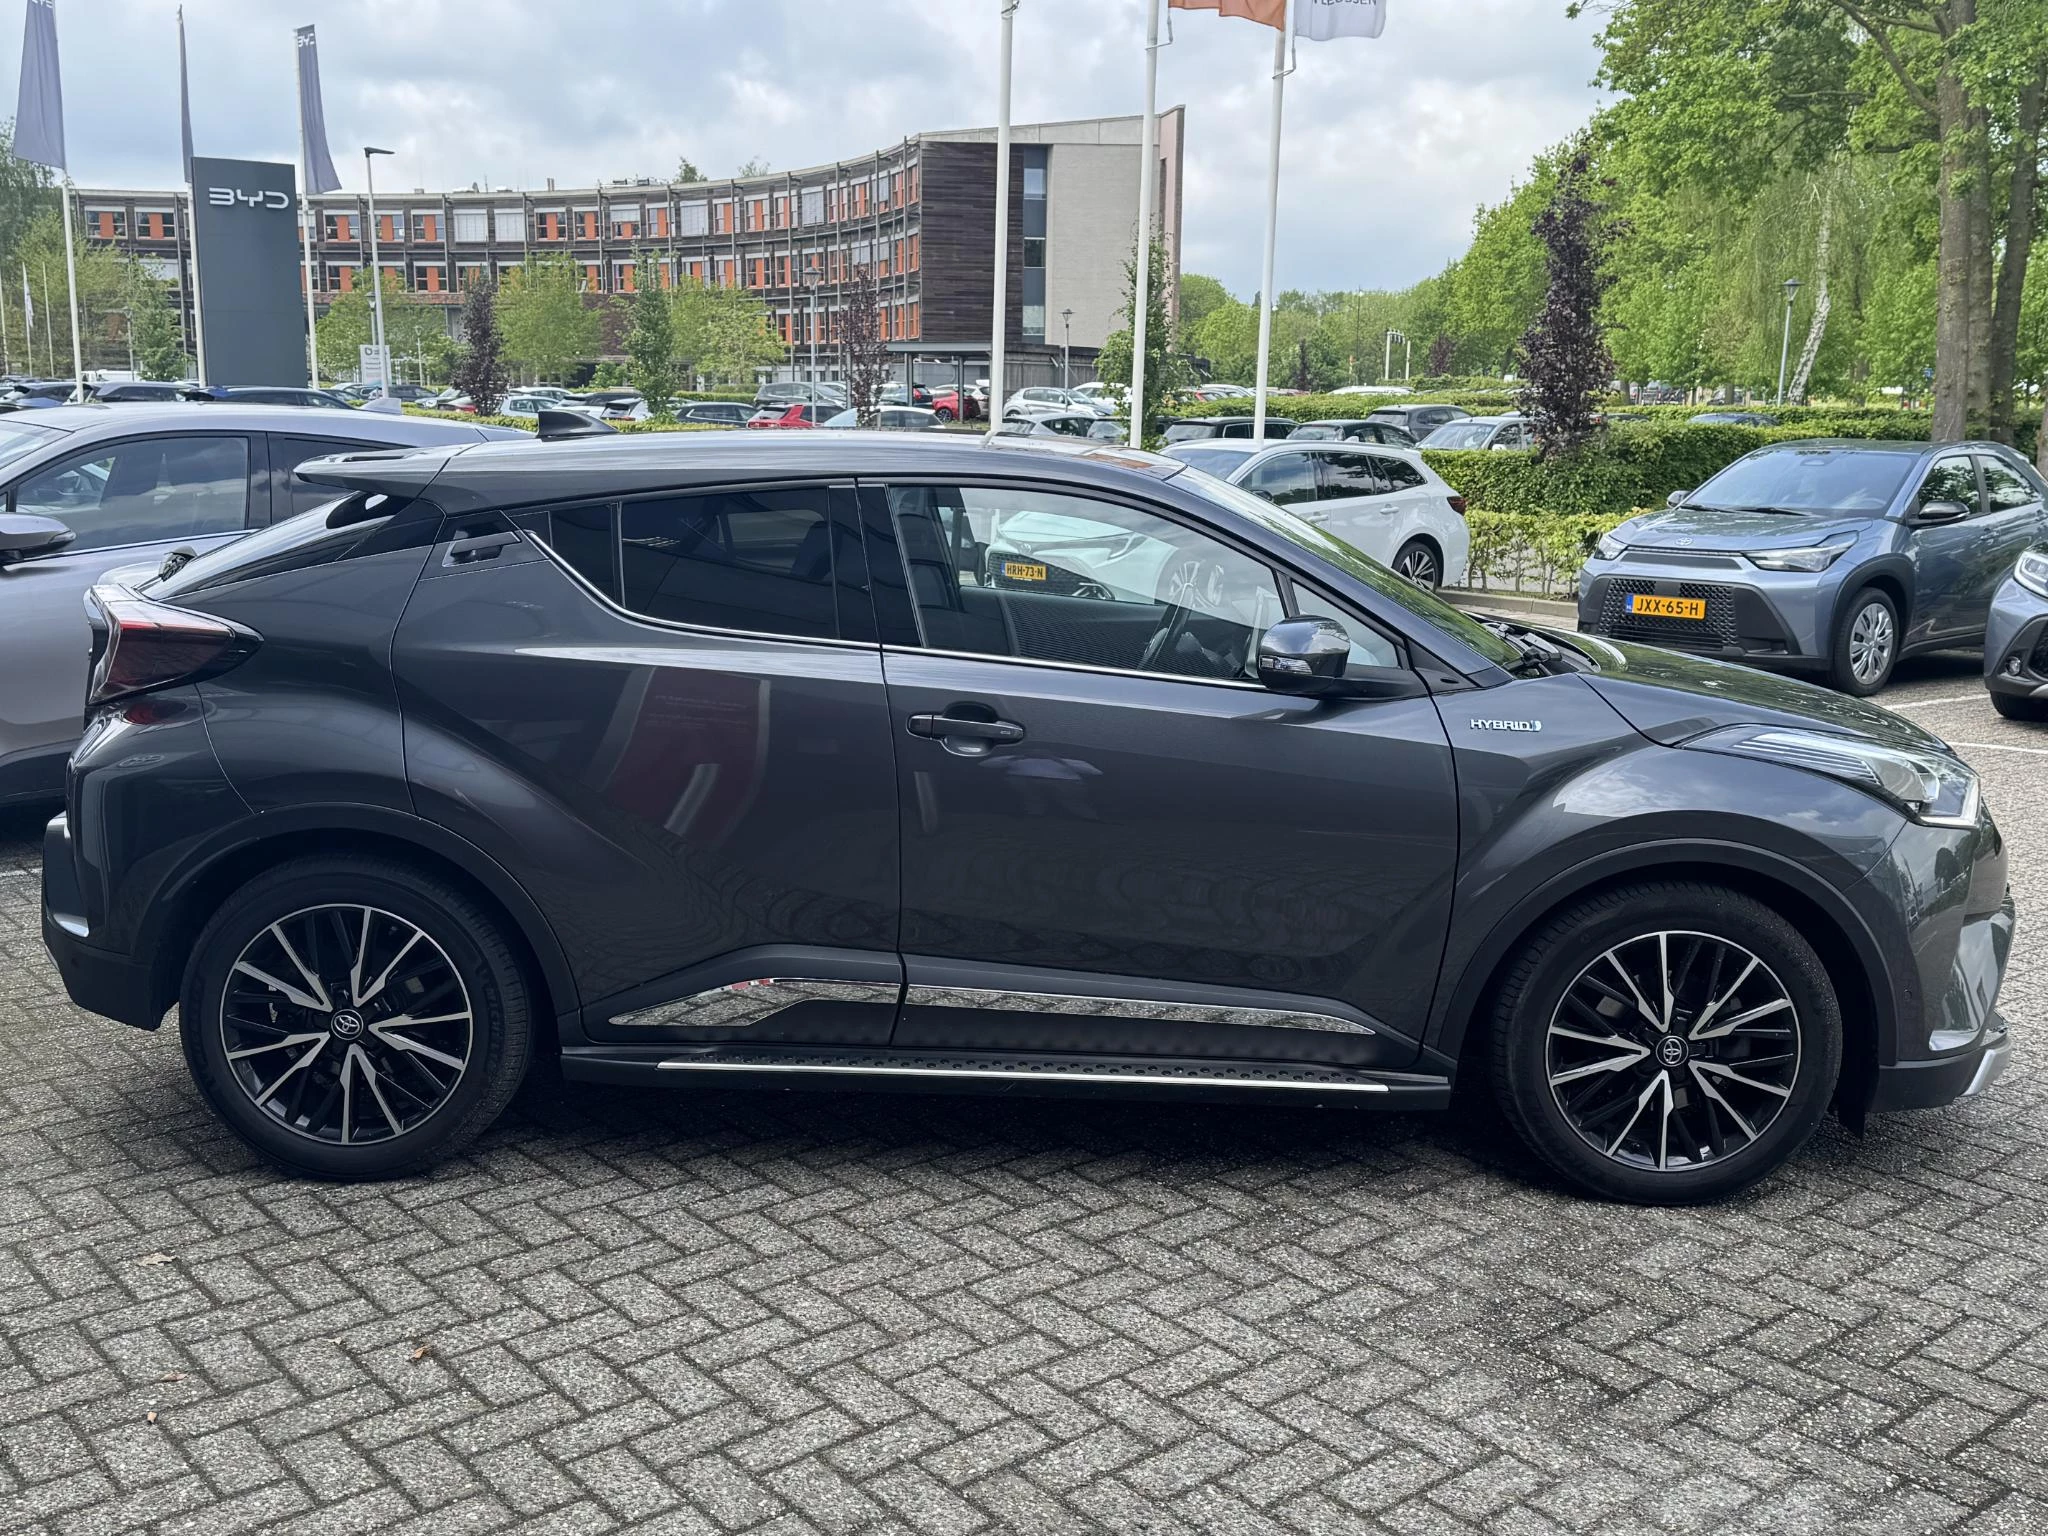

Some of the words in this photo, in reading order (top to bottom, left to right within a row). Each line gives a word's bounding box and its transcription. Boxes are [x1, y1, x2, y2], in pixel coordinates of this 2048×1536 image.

[209, 187, 290, 209] BYD
[1006, 564, 1043, 578] HRH-73-N
[1636, 598, 1699, 616] JXX-65-H
[1470, 718, 1531, 732] HYBRID
